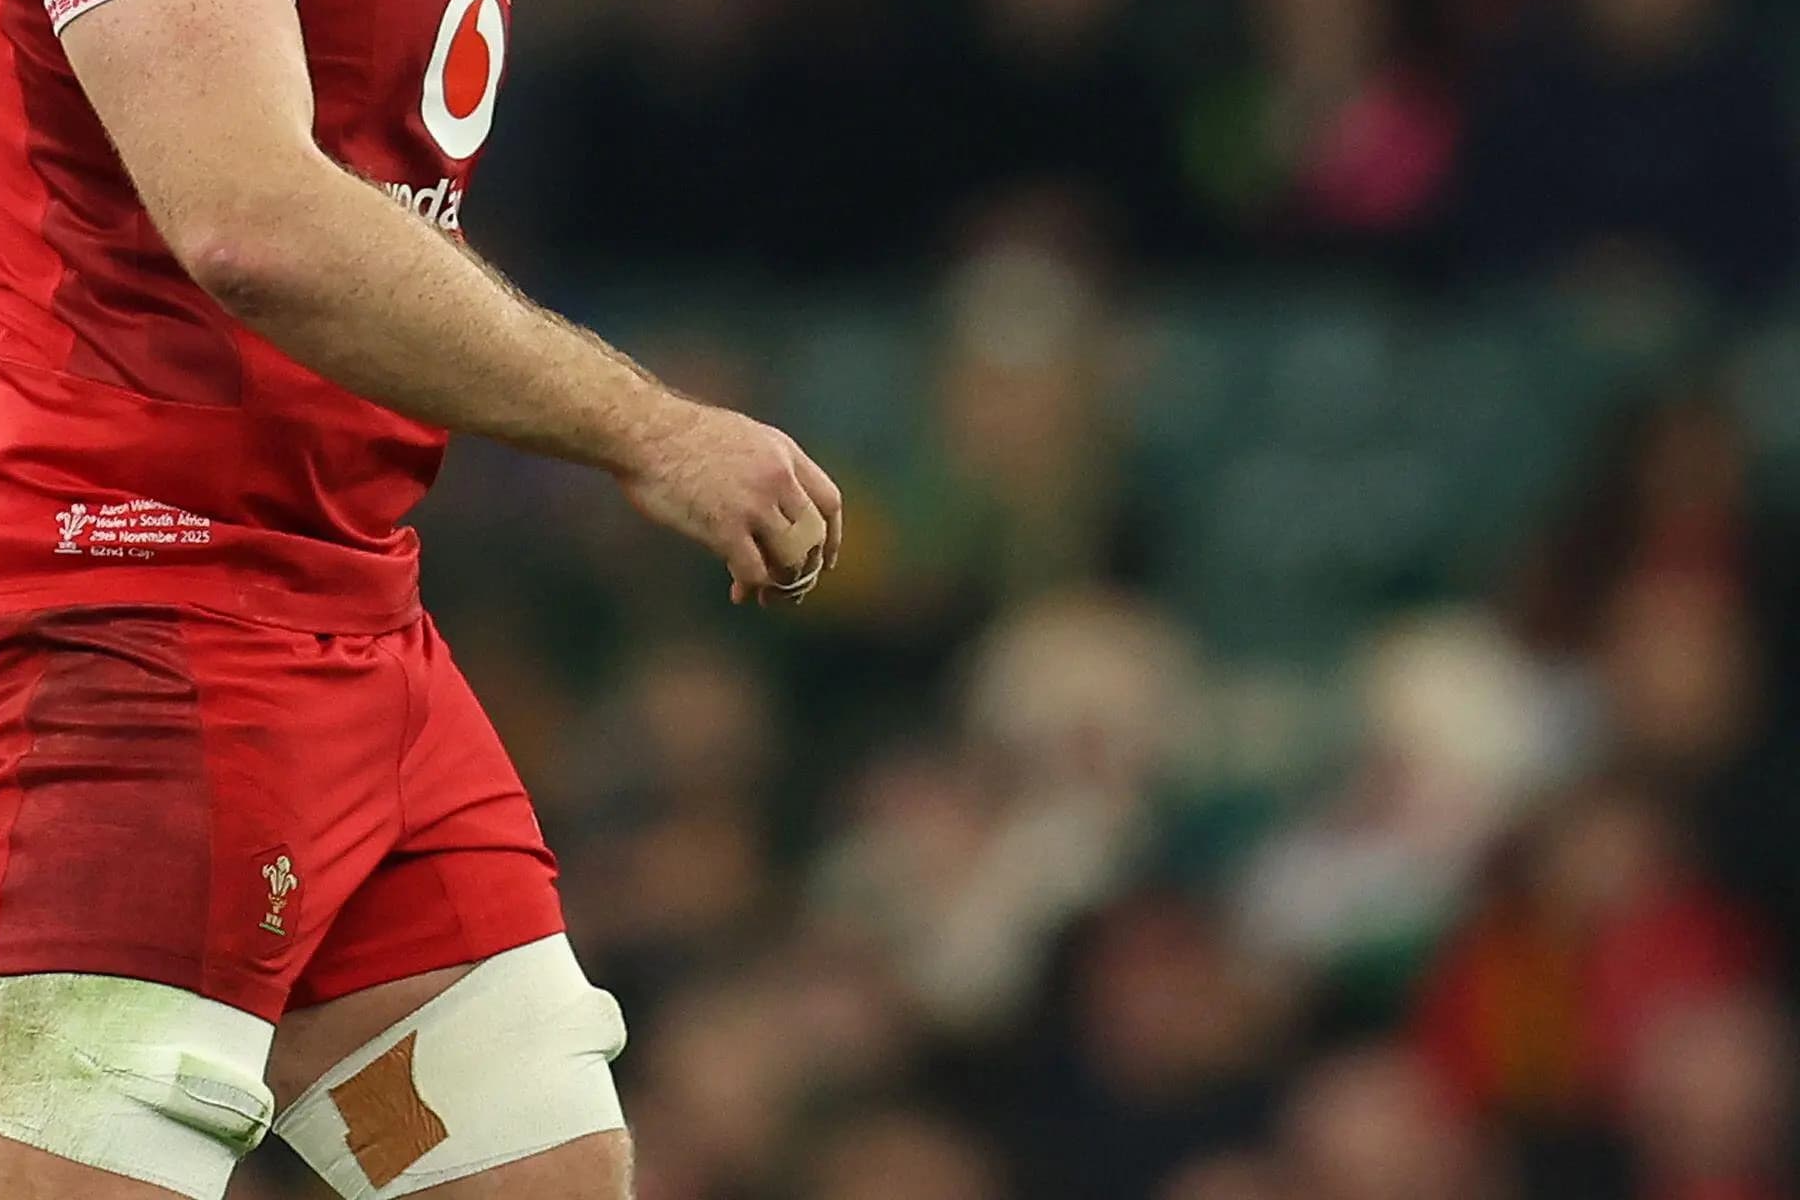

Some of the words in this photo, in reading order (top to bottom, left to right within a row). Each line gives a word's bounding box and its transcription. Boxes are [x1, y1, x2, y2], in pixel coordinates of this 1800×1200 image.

[129, 518, 137, 527] v
[140, 513, 173, 526] South
[177, 512, 210, 527] Africa
[119, 531, 177, 543] November
[180, 531, 210, 543] 2025
